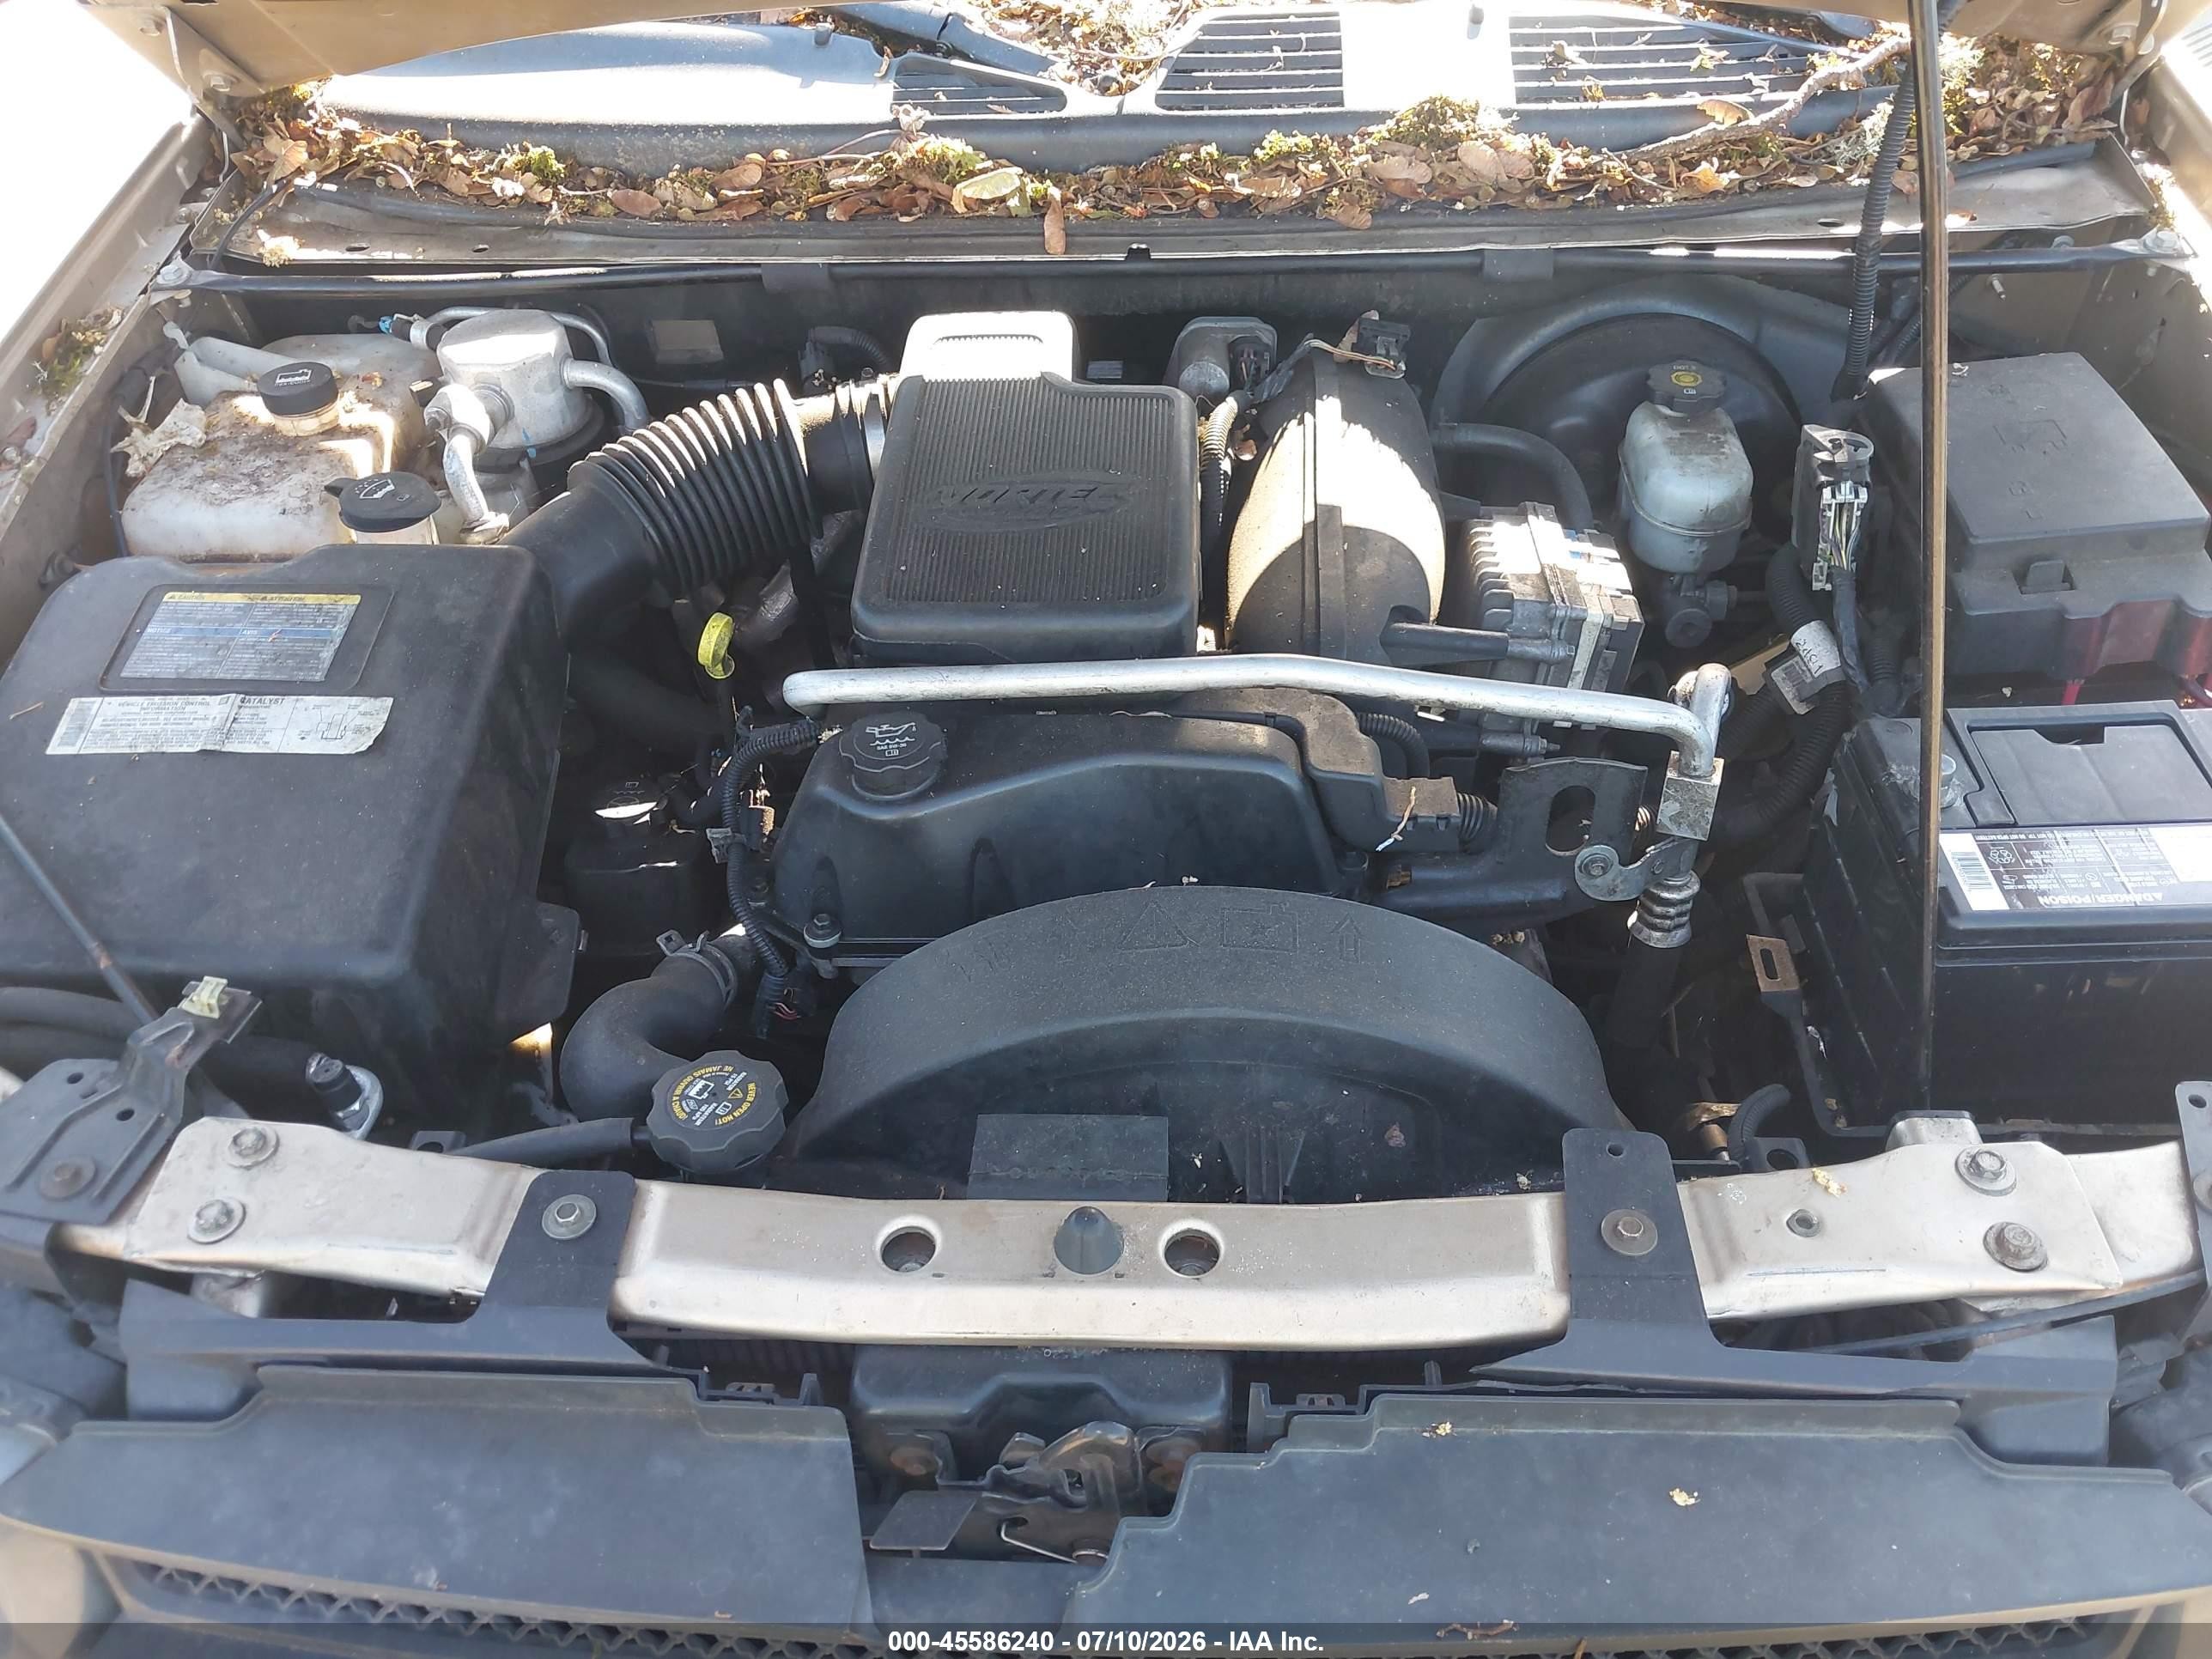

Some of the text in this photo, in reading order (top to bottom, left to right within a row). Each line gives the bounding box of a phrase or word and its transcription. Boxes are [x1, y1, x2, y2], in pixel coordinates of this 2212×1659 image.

[240, 696, 285, 705] CATALYST
[693, 1065, 722, 1078] JAMAIS
[747, 1082, 757, 1102] NEVER
